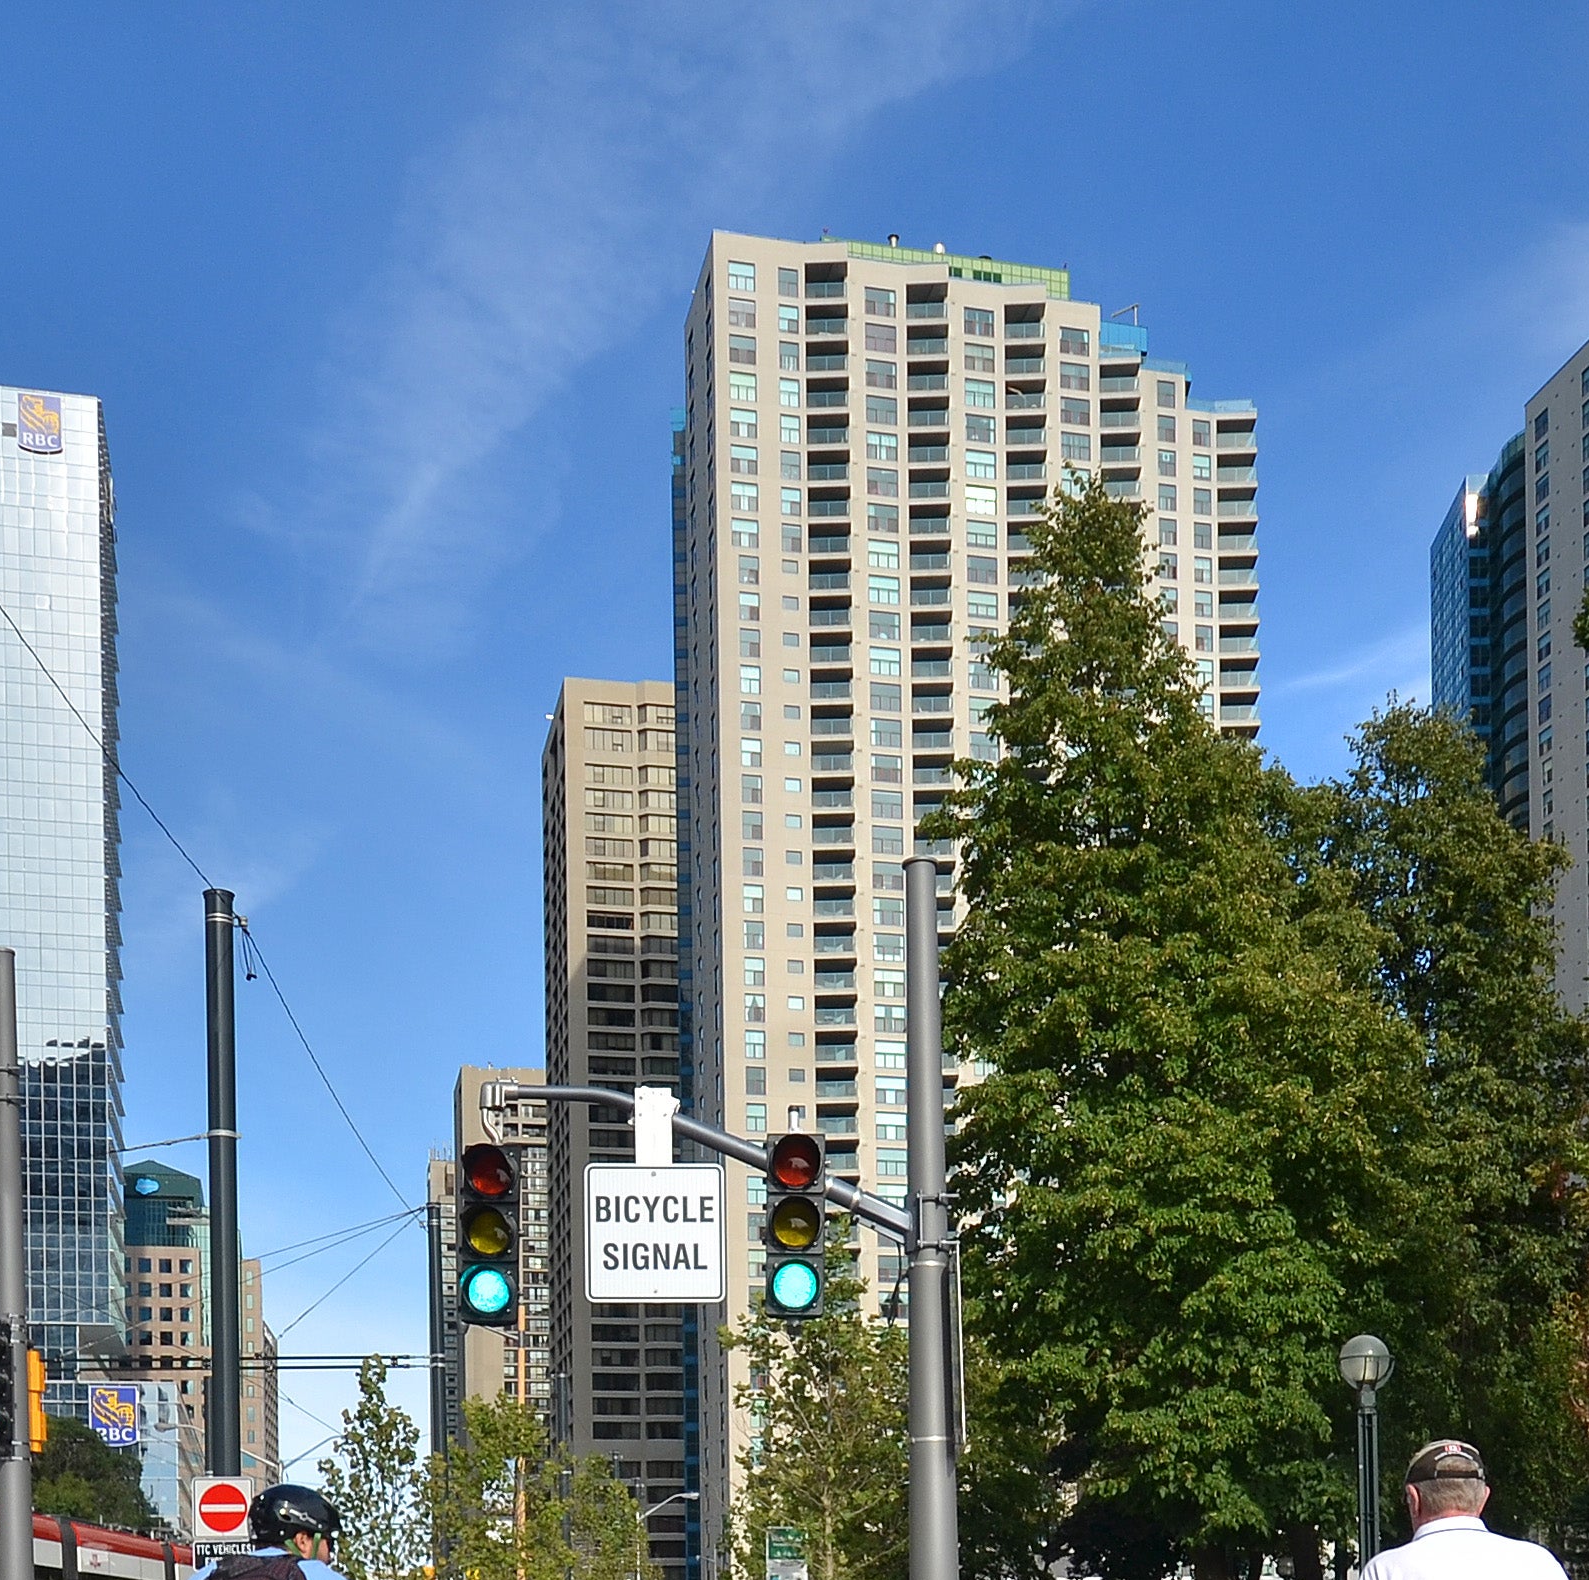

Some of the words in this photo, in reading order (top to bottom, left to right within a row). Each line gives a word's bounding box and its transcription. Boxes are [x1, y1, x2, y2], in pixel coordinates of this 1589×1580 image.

[23, 432, 58, 447] RBC
[595, 1195, 714, 1223] BICYCLE
[603, 1243, 707, 1270] SIGNAL
[196, 1544, 211, 1555] TTC
[213, 1544, 252, 1555] VEHICLES
